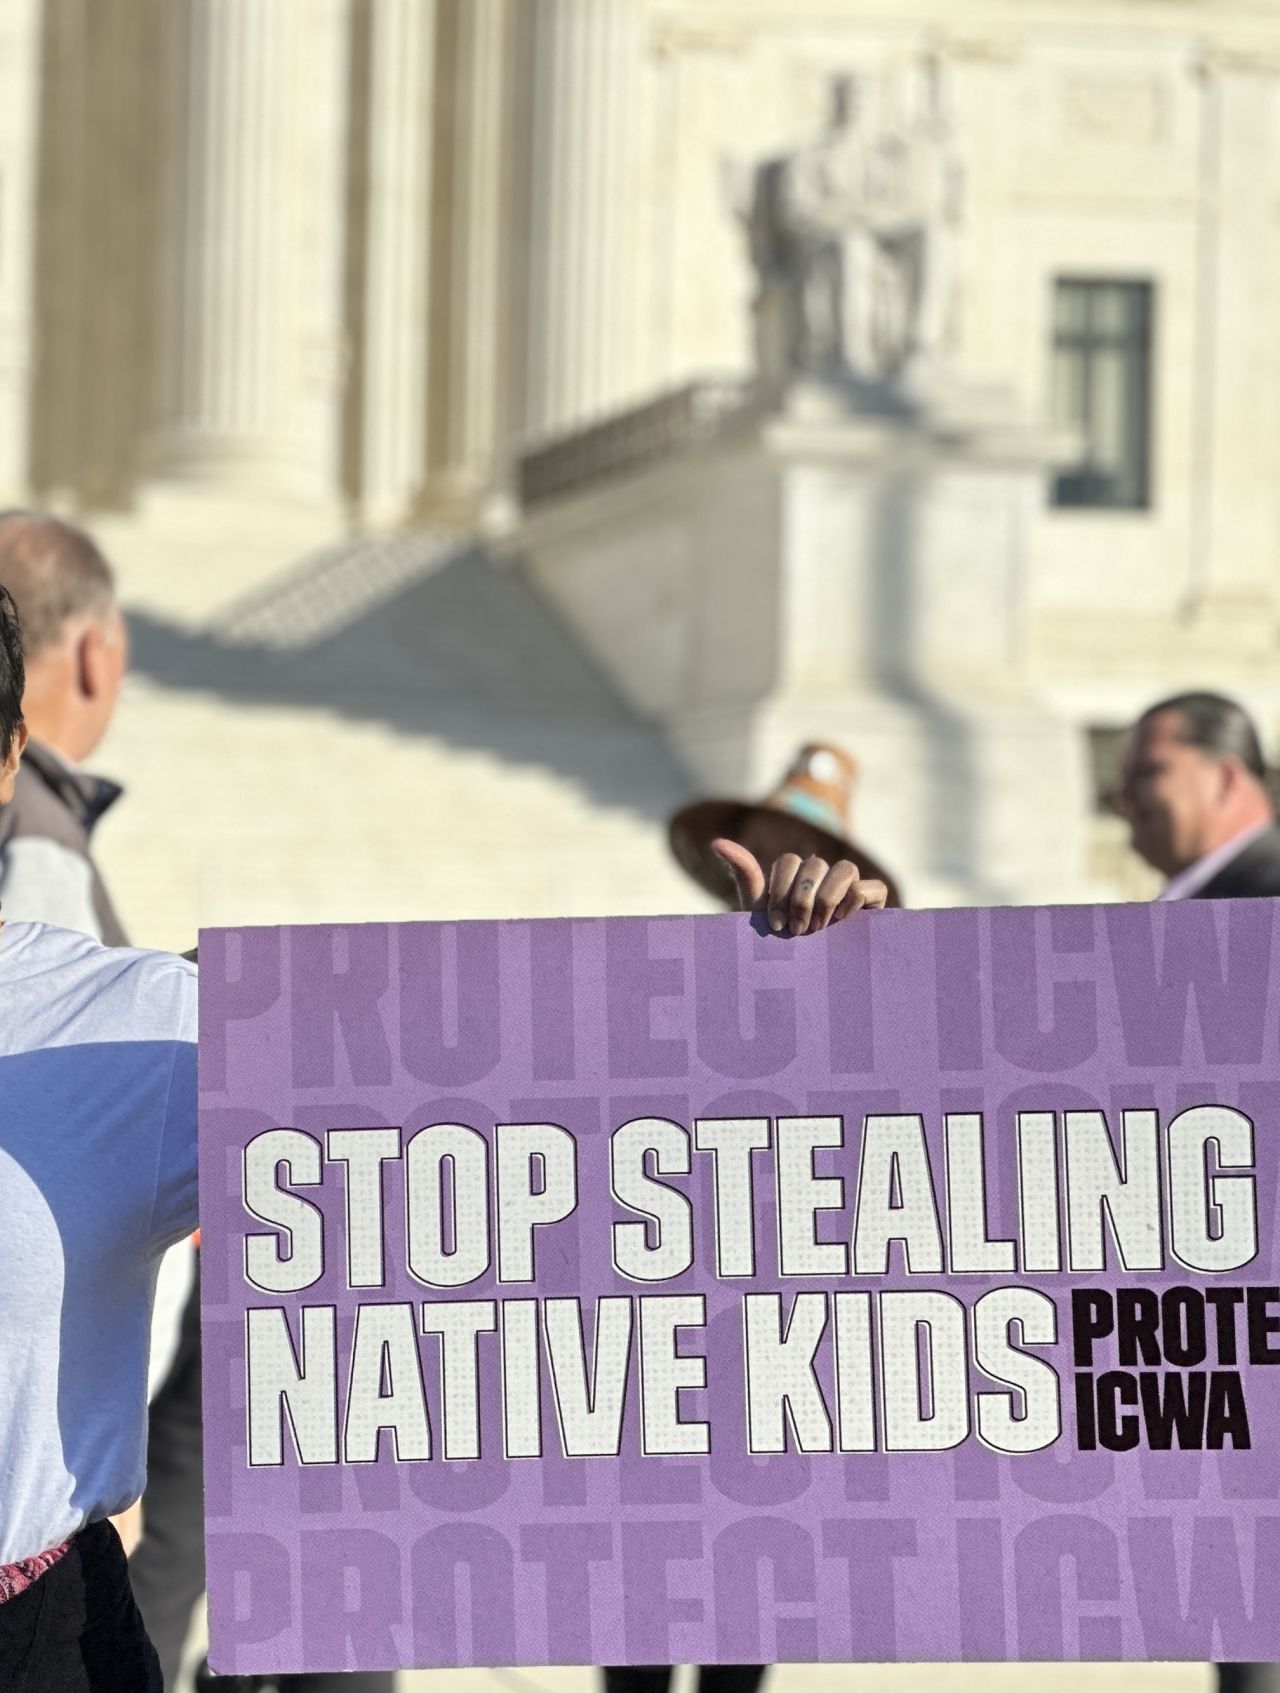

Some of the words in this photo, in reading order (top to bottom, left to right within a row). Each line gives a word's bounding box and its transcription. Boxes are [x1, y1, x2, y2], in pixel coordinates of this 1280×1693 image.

[243, 1121, 577, 1294] STOP
[610, 1104, 1259, 1283] STEALING
[246, 1293, 711, 1468] NATIVE
[743, 1286, 1062, 1455] KIDS
[1071, 1286, 1280, 1367] PROTE
[1075, 1371, 1251, 1451] ICWA
